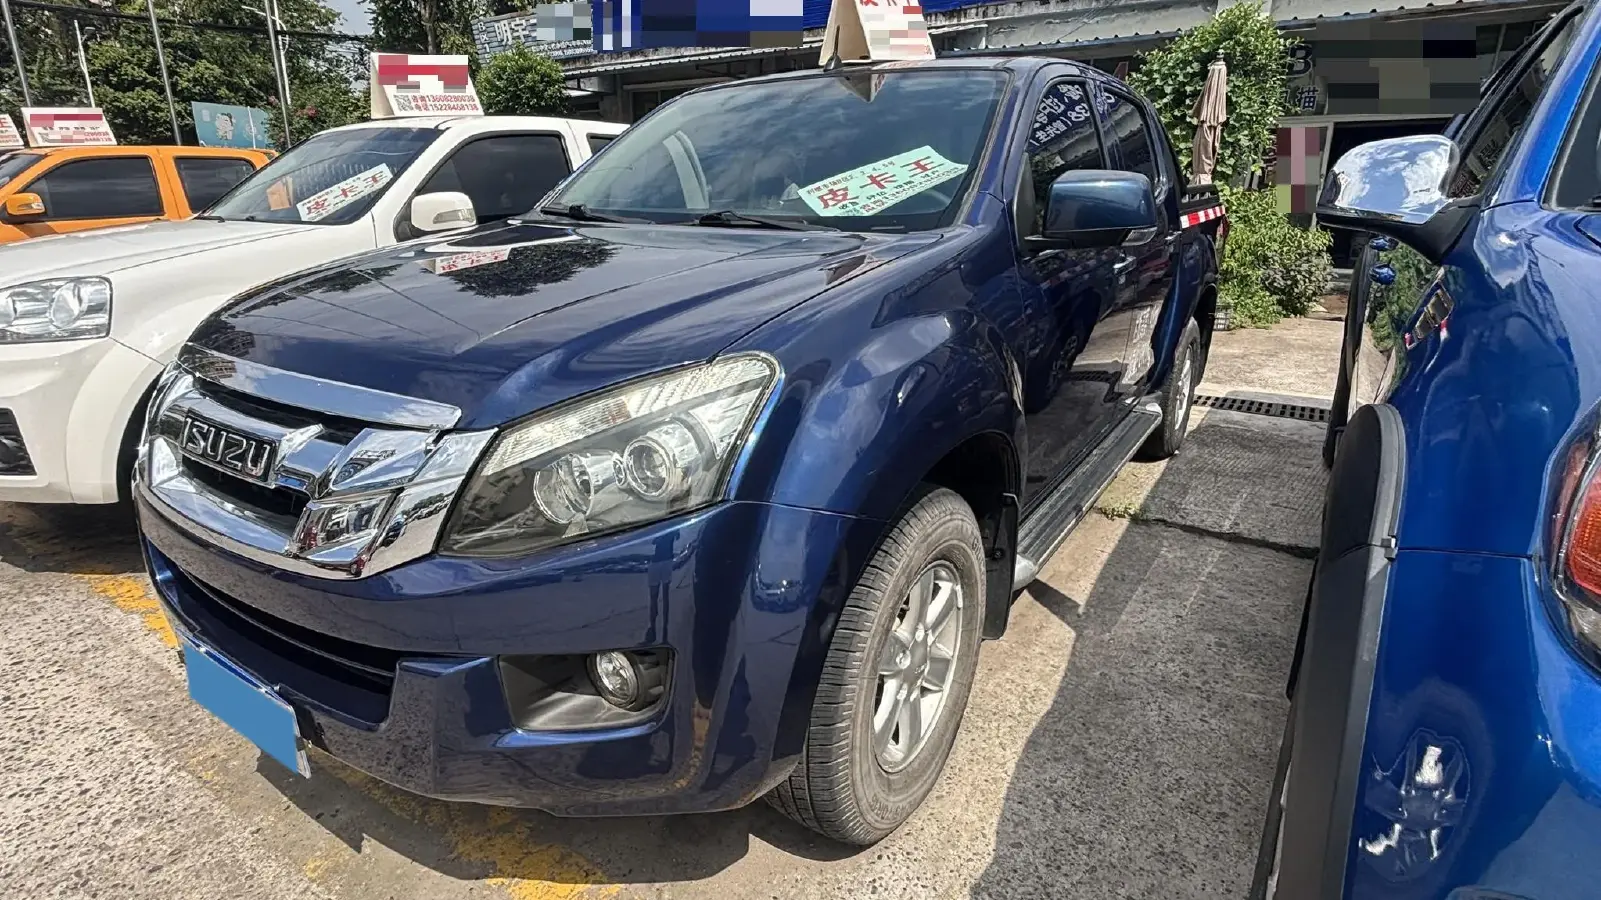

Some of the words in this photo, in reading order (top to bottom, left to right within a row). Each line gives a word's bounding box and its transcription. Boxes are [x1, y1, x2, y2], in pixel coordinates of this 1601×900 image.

[306, 170, 388, 215] 皮卡王
[817, 155, 945, 210] 皮卡王
[181, 417, 271, 478] ISUZU
